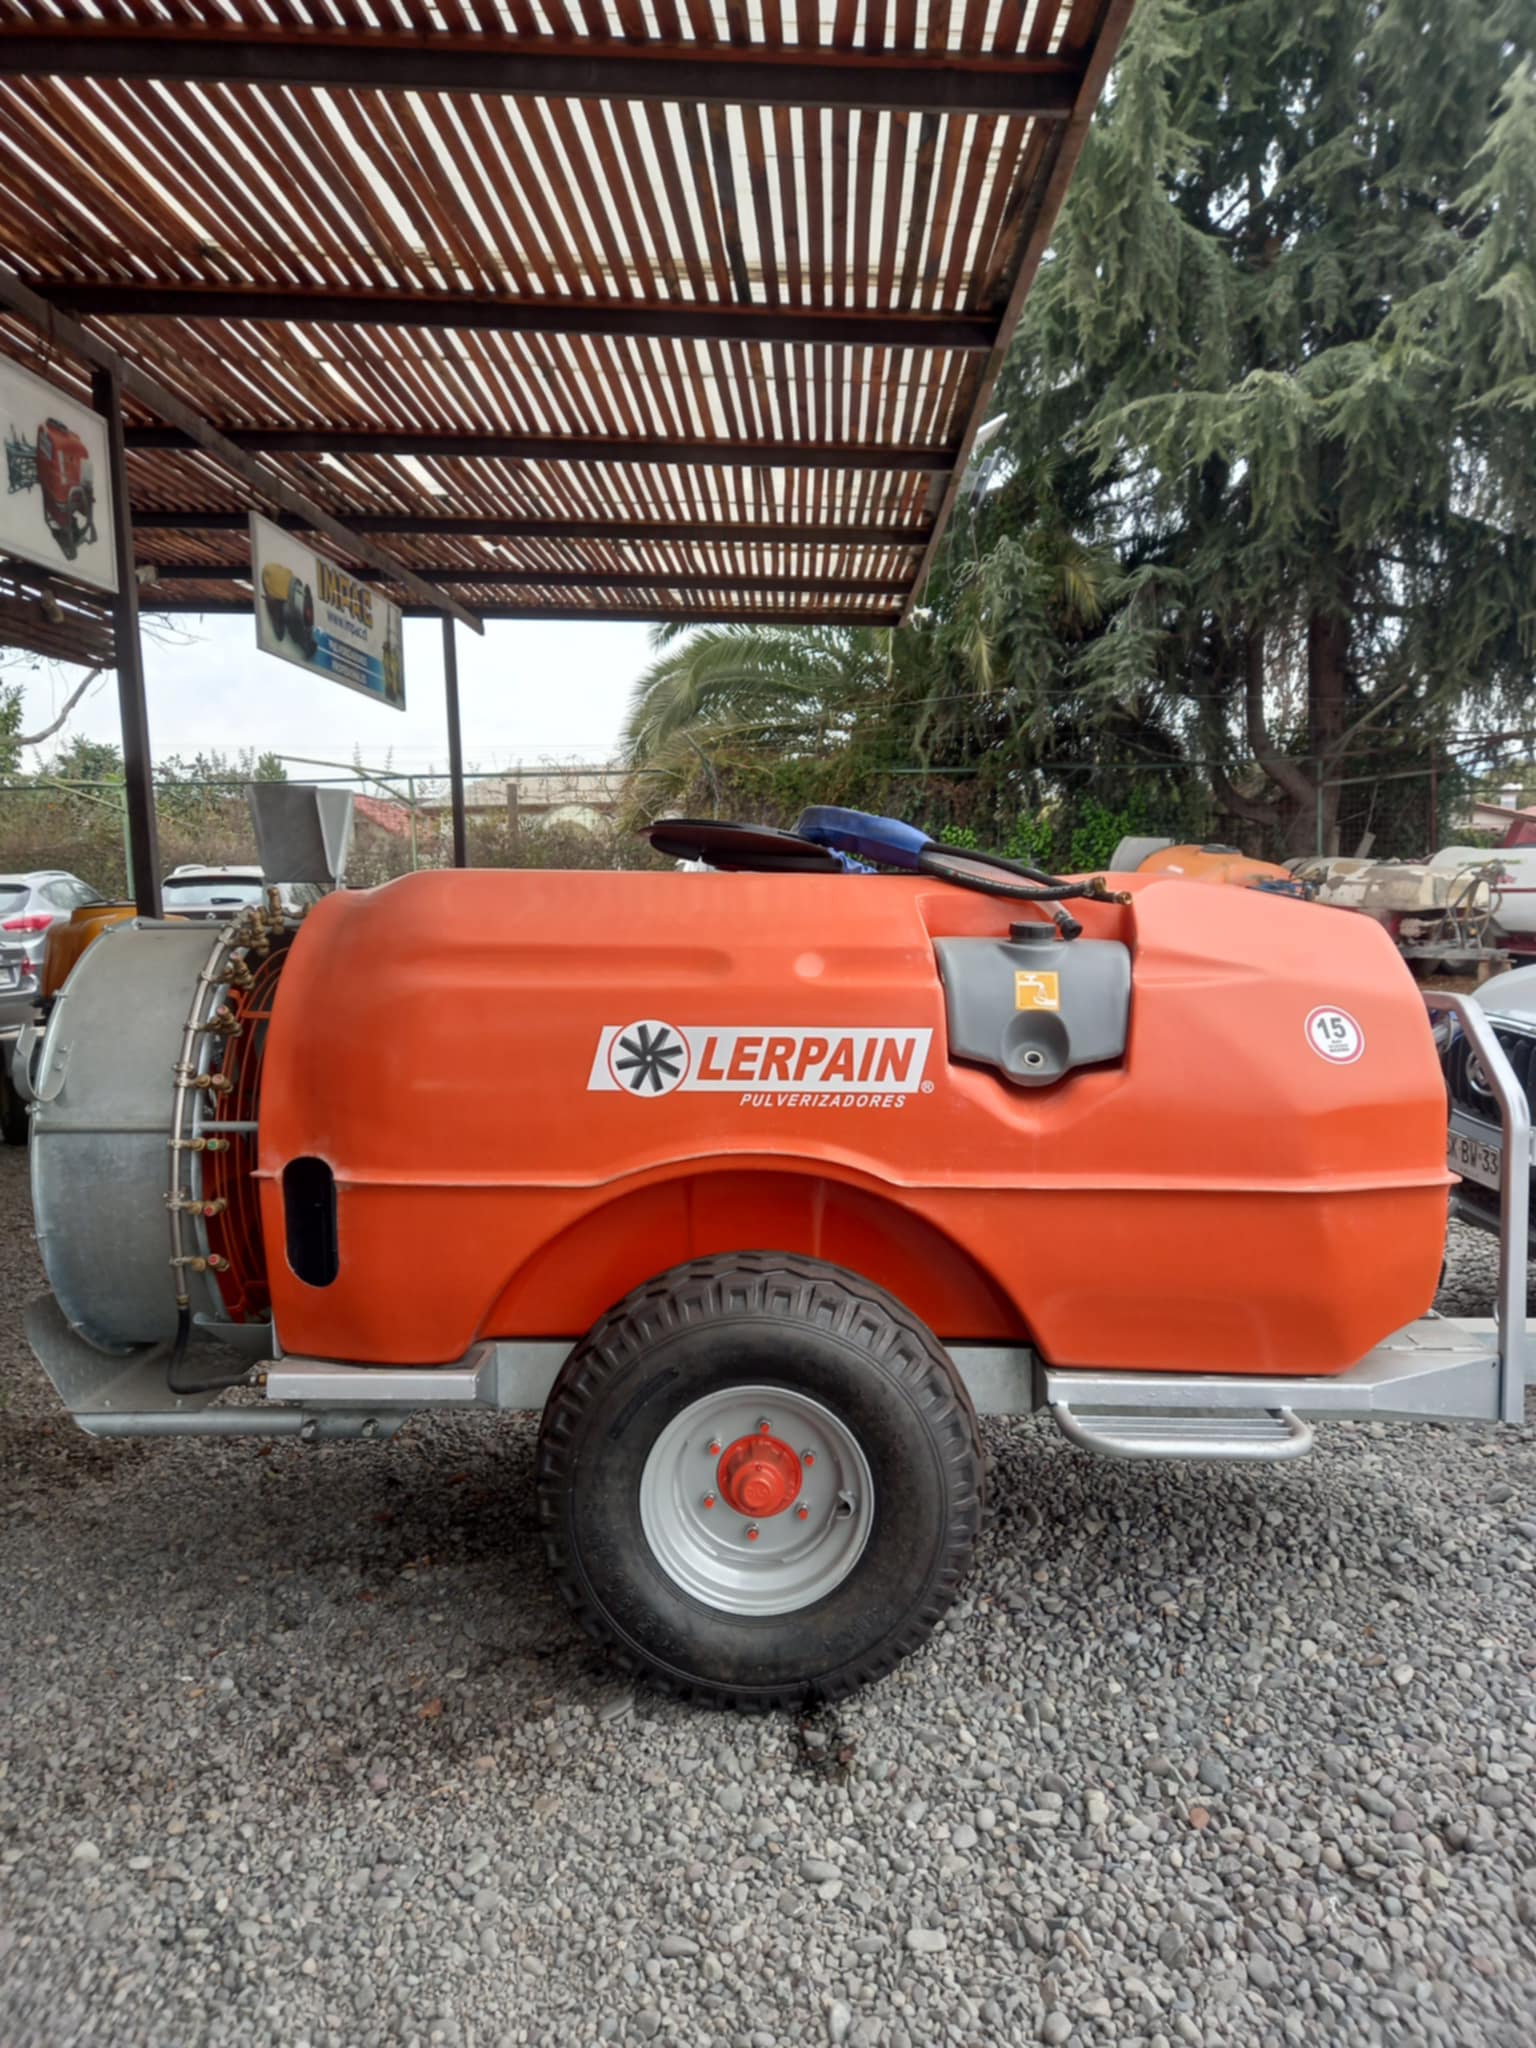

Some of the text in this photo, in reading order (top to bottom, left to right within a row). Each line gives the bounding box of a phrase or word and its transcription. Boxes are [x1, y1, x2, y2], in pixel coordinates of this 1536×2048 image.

[1317, 1017, 1346, 1039] 15
[696, 1036, 917, 1082] LERPAIN
[739, 1092, 907, 1109] PULVERIZADORES
